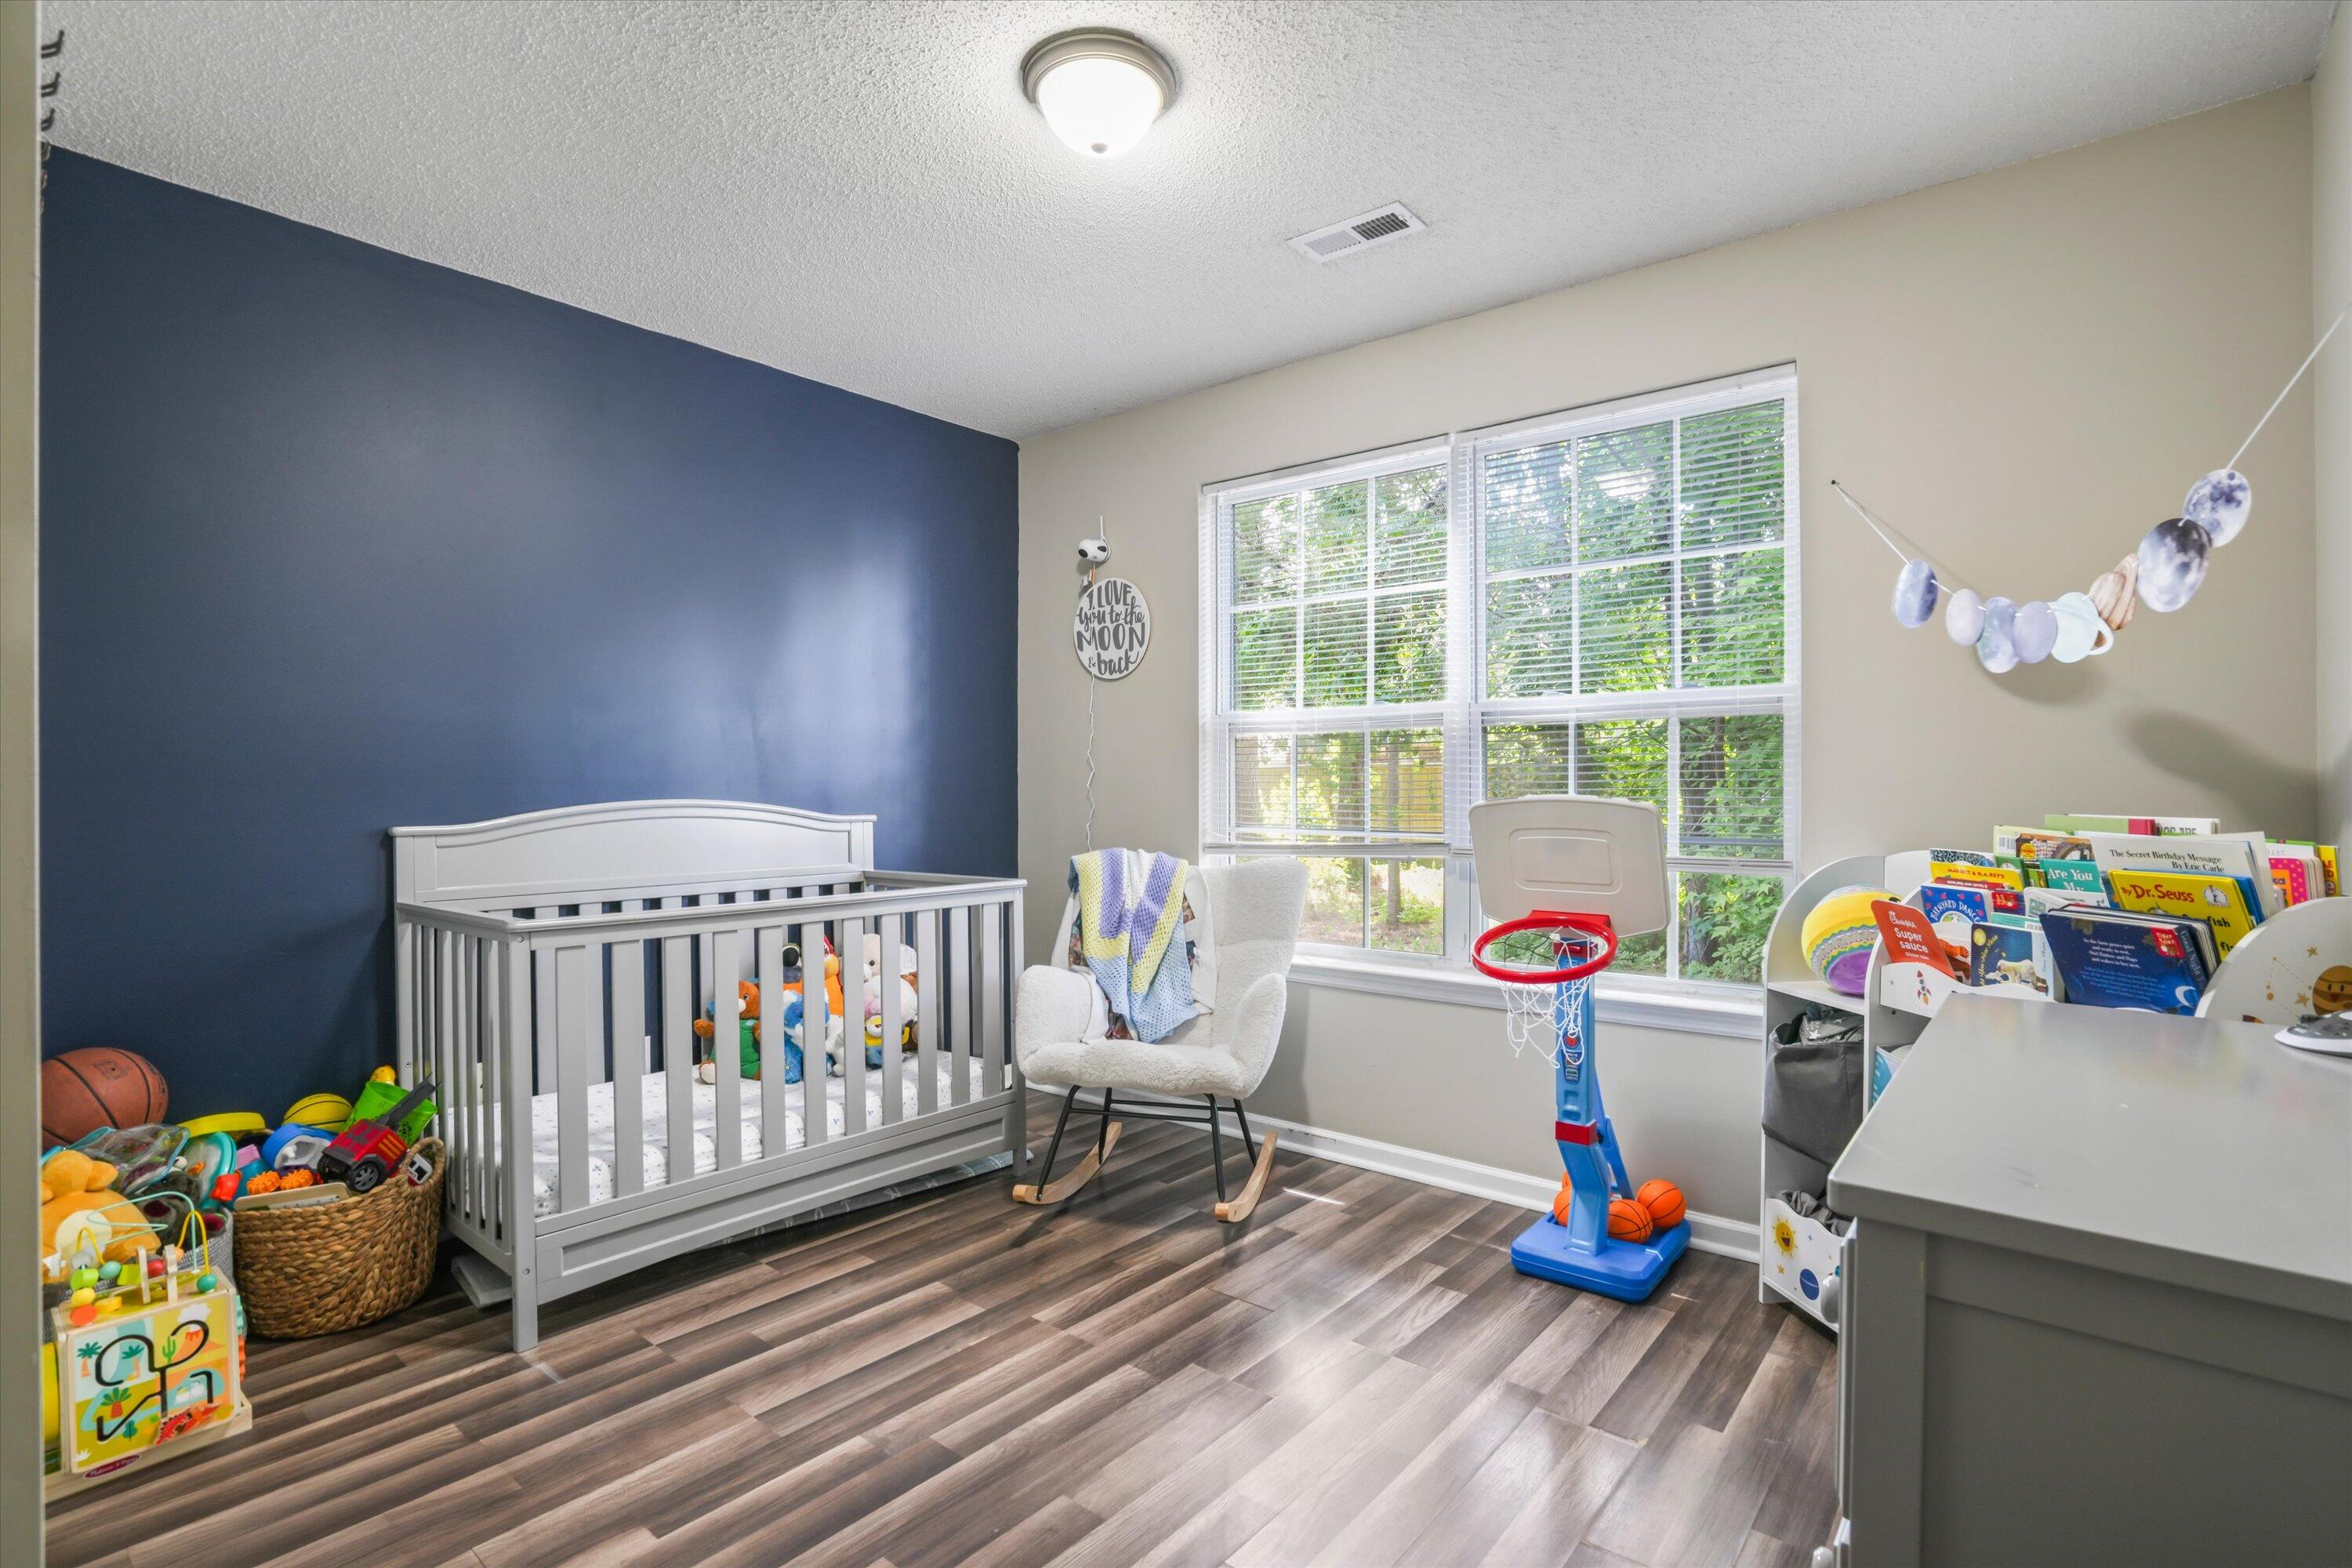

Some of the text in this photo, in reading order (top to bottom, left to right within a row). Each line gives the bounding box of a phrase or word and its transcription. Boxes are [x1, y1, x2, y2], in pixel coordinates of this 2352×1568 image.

[1087, 580, 1132, 610] I LOVE
[1076, 596, 1145, 632] you to the
[1076, 622, 1145, 652] MOON
[1097, 648, 1139, 676] back
[2125, 850, 2150, 858] Secret
[2152, 851, 2186, 861] Birthday
[2187, 853, 2221, 863] Message
[2048, 868, 2093, 881] Are You
[2172, 861, 2183, 869] By
[2203, 864, 2225, 873] Carle
[2121, 887, 2132, 896] By
[2130, 884, 2155, 899] Dr.
[2154, 884, 2194, 902] Seuss
[1930, 899, 1957, 921] BARNYARD
[1894, 927, 1923, 942] Super
[1900, 941, 1928, 953] sauce
